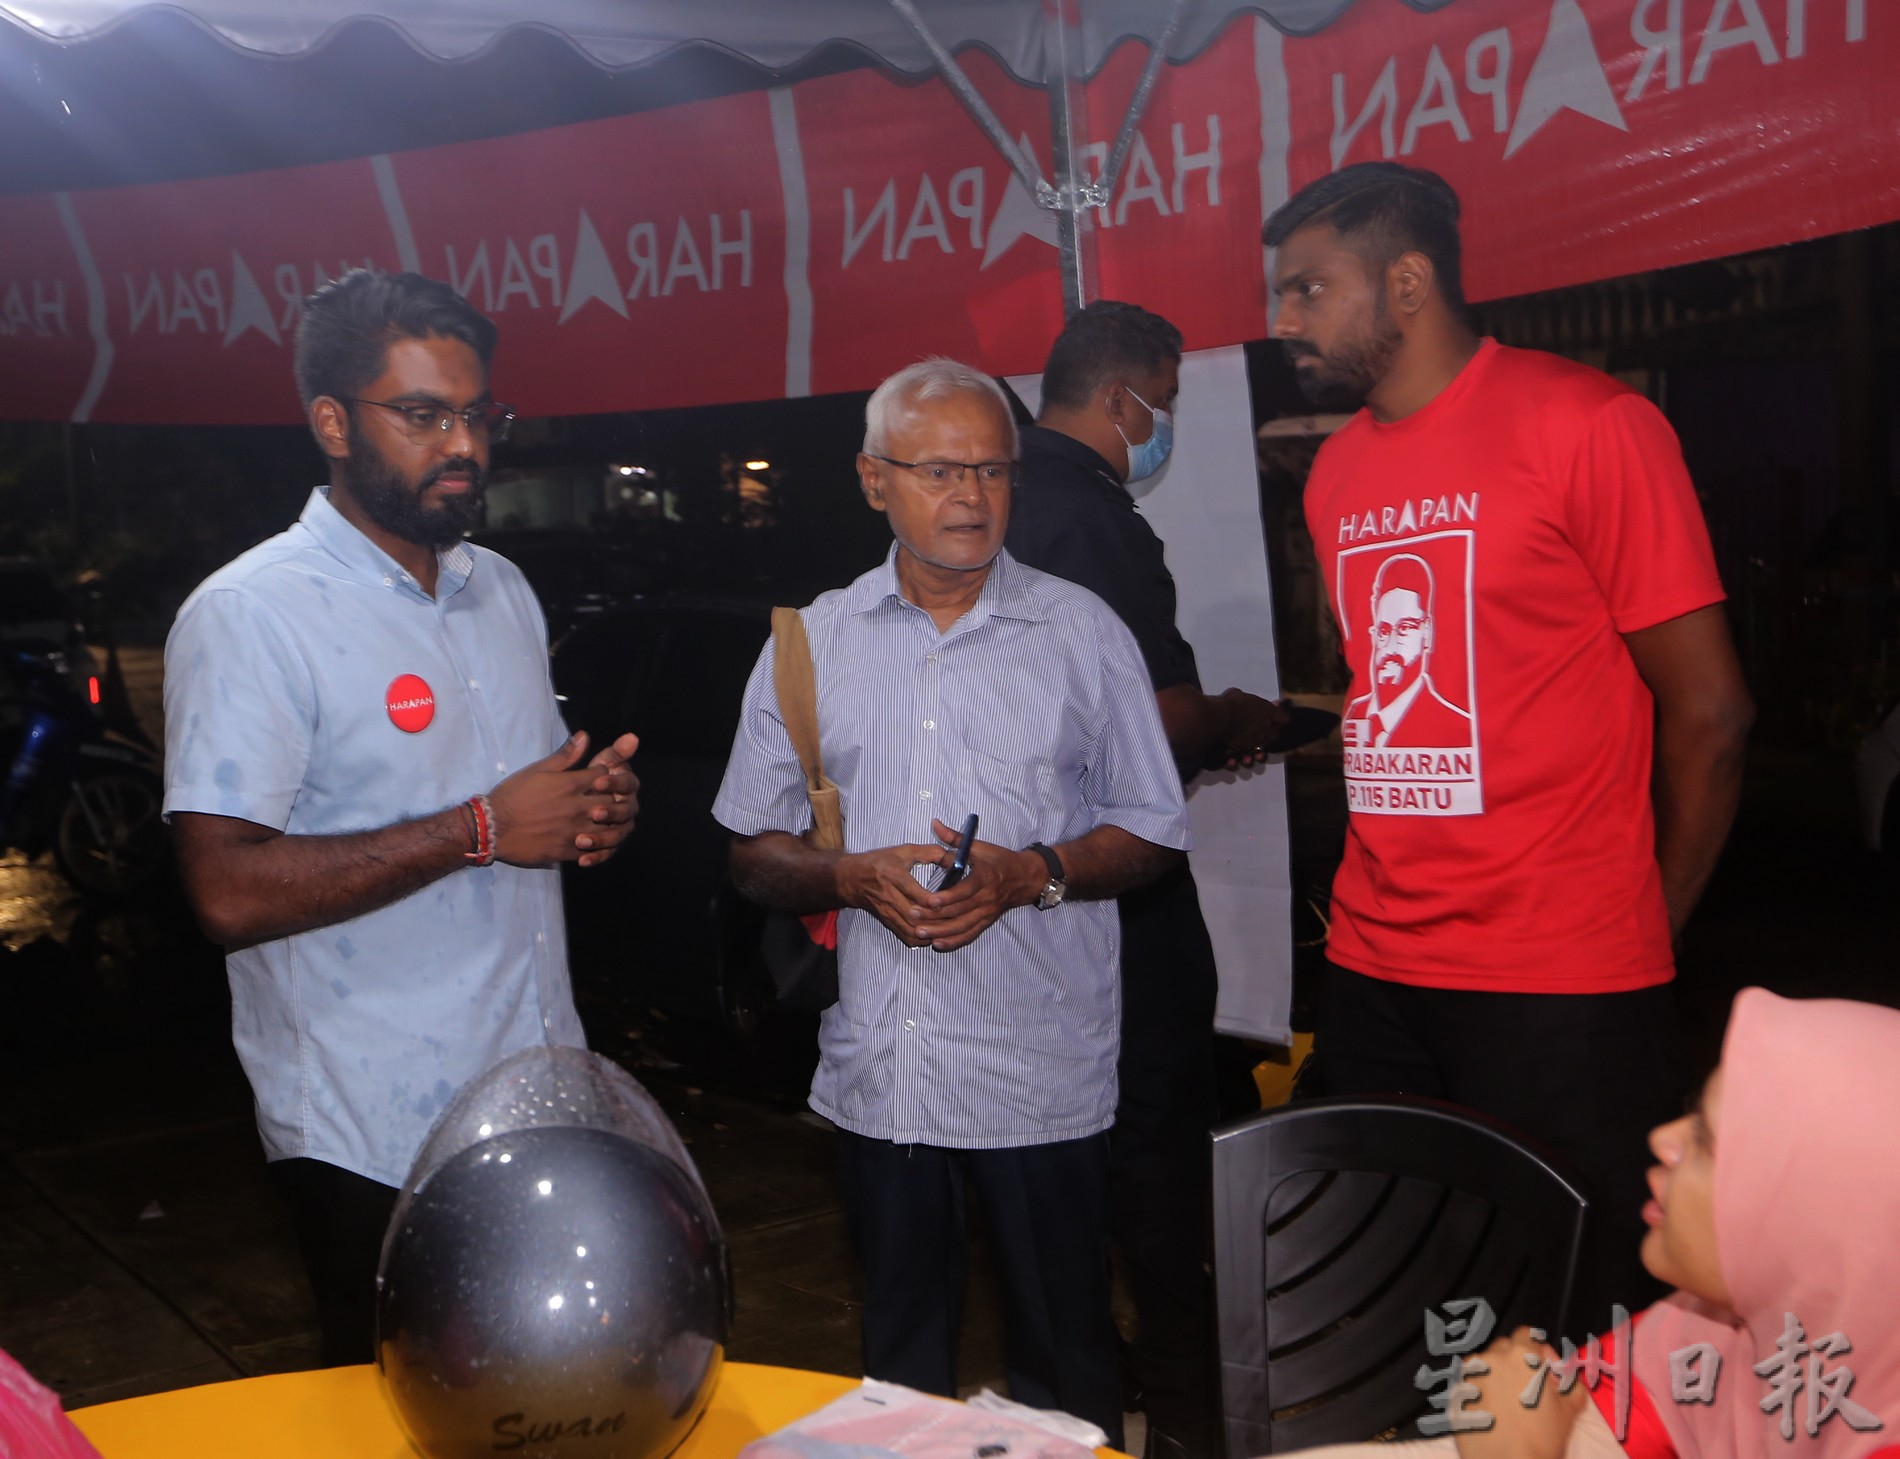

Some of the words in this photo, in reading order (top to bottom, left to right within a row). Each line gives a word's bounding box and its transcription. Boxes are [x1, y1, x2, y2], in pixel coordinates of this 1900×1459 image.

[1338, 491, 1480, 544] HARAPAN
[389, 696, 433, 712] HARAPAN
[1349, 784, 1385, 809] P.115
[1389, 786, 1453, 810] BATU
[491, 1410, 626, 1451] Swan
